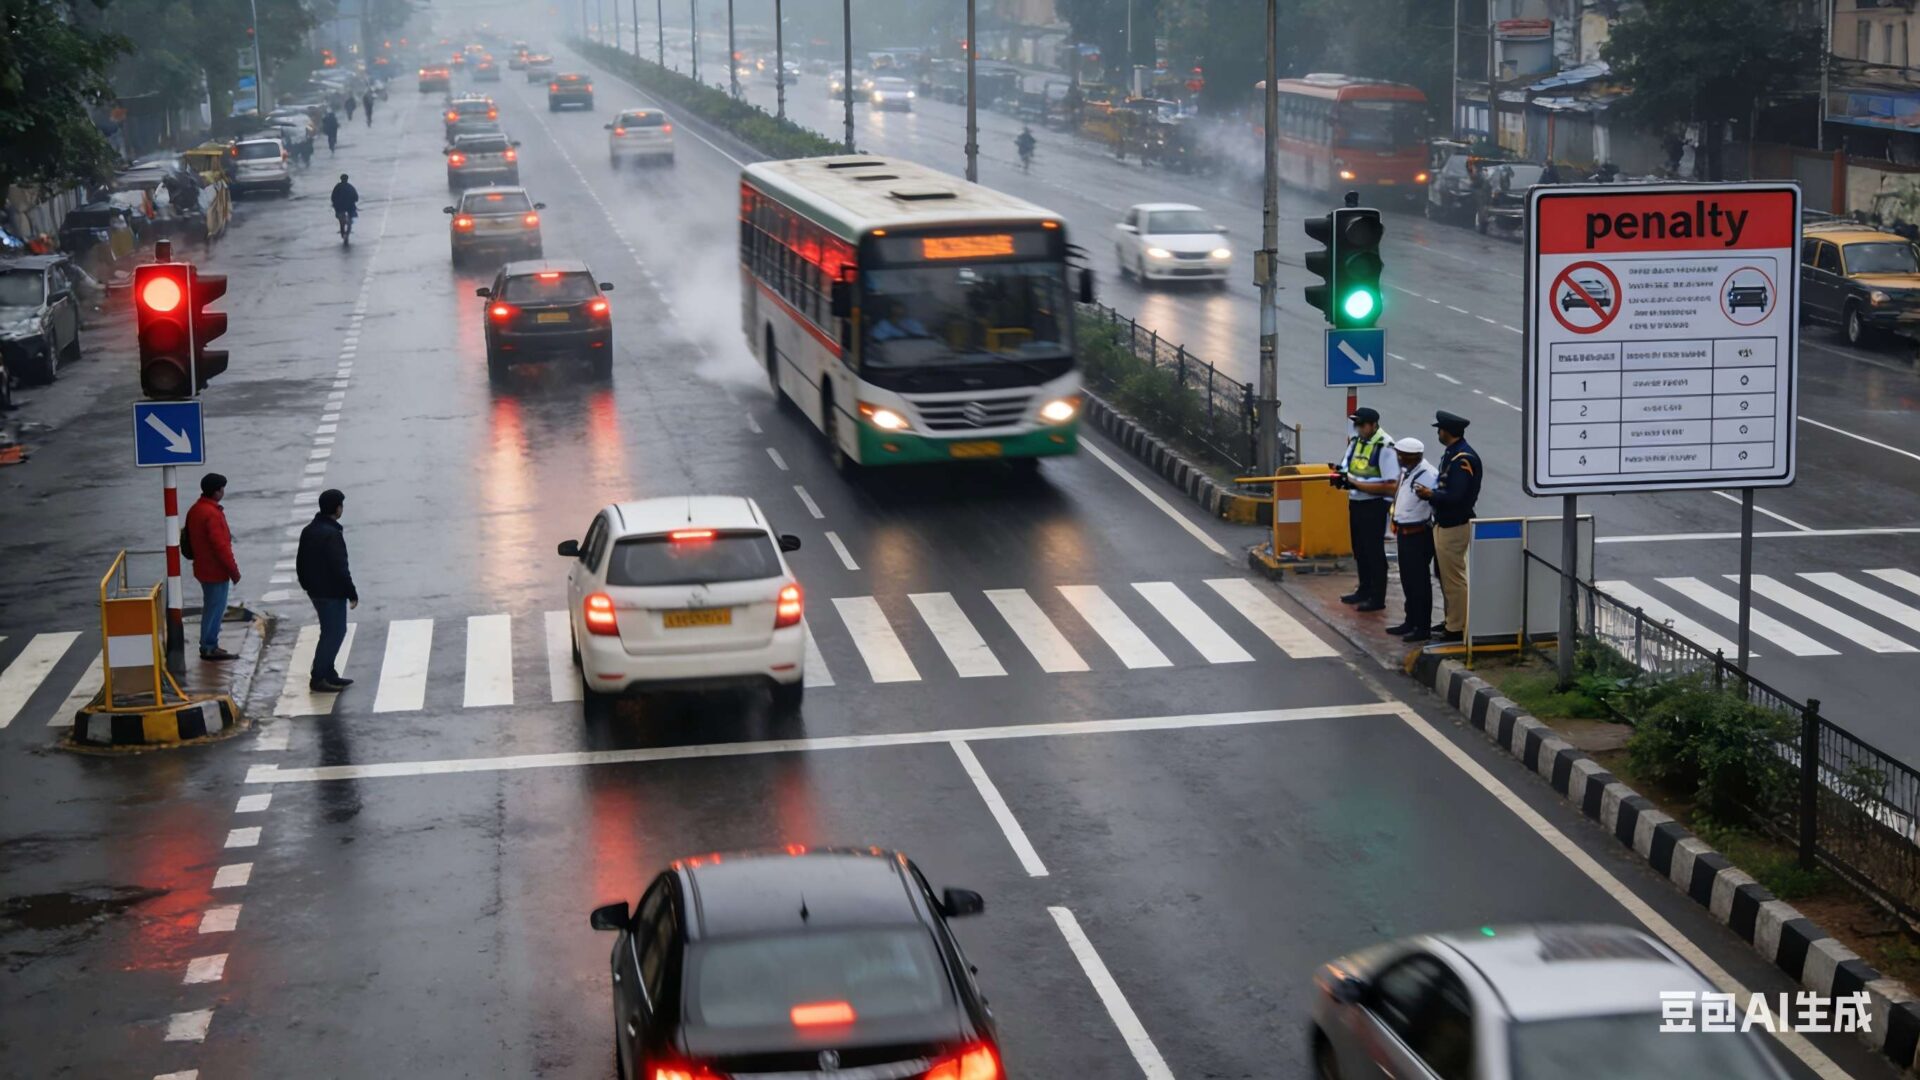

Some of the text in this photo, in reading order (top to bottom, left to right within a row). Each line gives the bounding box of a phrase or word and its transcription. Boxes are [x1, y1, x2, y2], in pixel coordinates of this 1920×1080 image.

[1586, 200, 1749, 249] penalty
[1581, 380, 1587, 392] 1
[1580, 404, 1588, 417] 2
